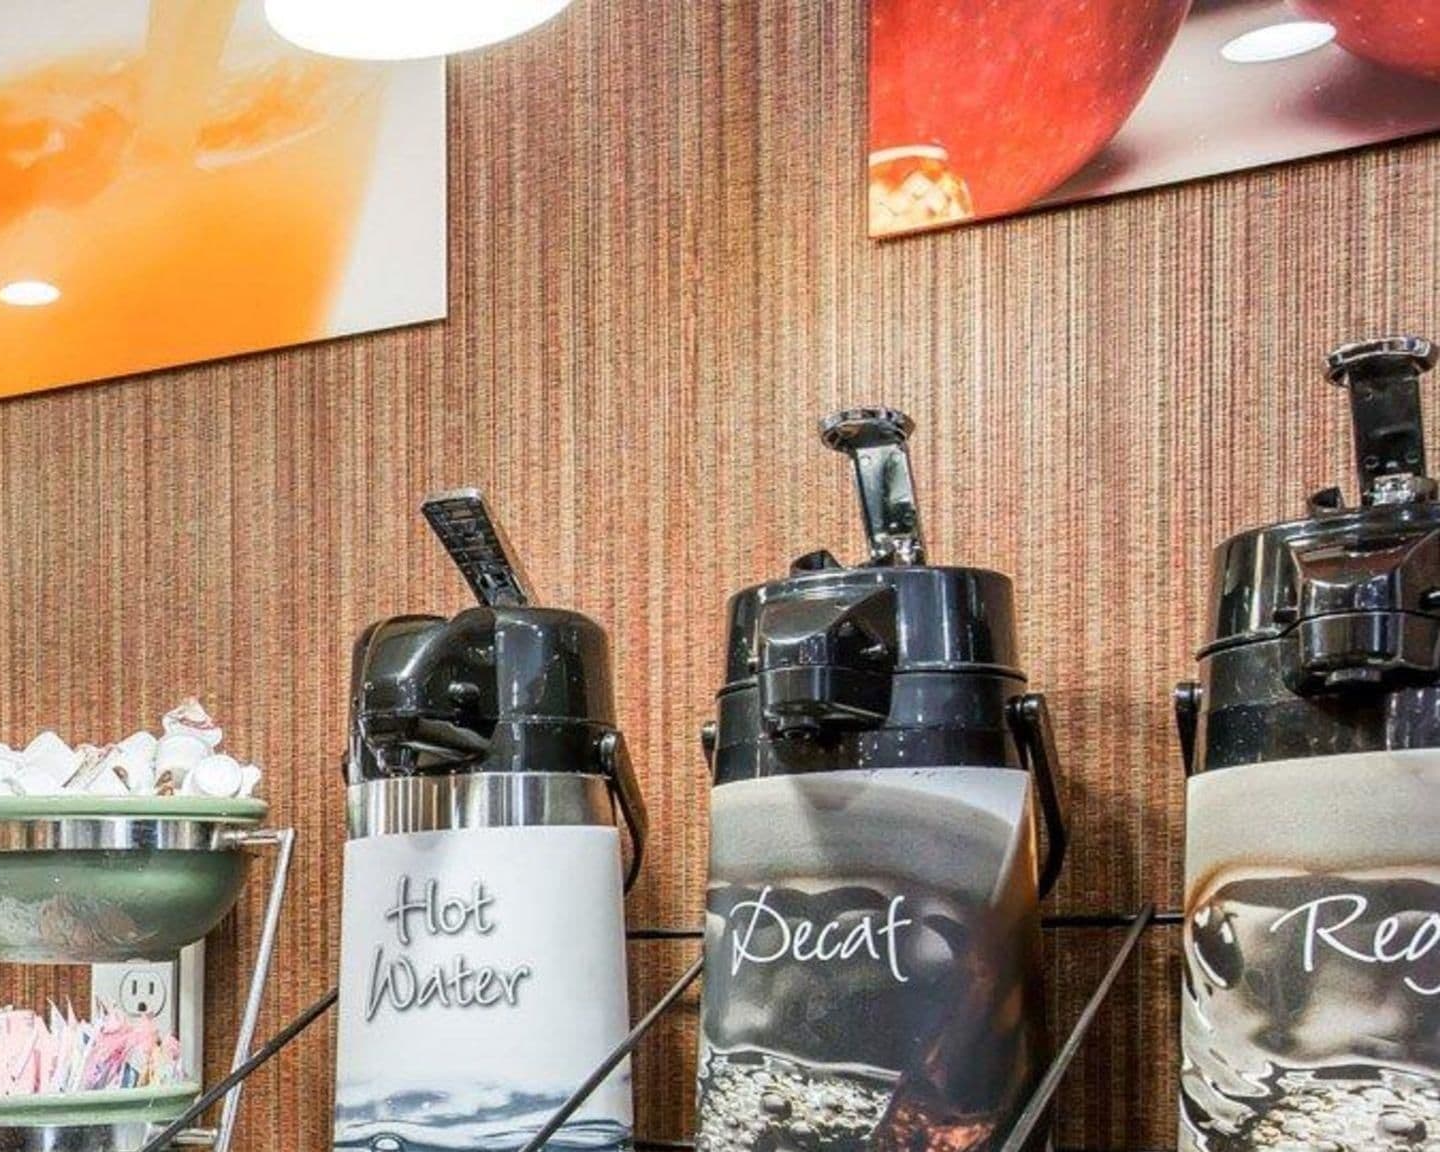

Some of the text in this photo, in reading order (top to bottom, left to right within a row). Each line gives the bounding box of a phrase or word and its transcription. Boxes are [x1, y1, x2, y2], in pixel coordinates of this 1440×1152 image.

[385, 874, 495, 945] Hot
[729, 885, 912, 983] Decaf
[366, 943, 531, 1022] Water
